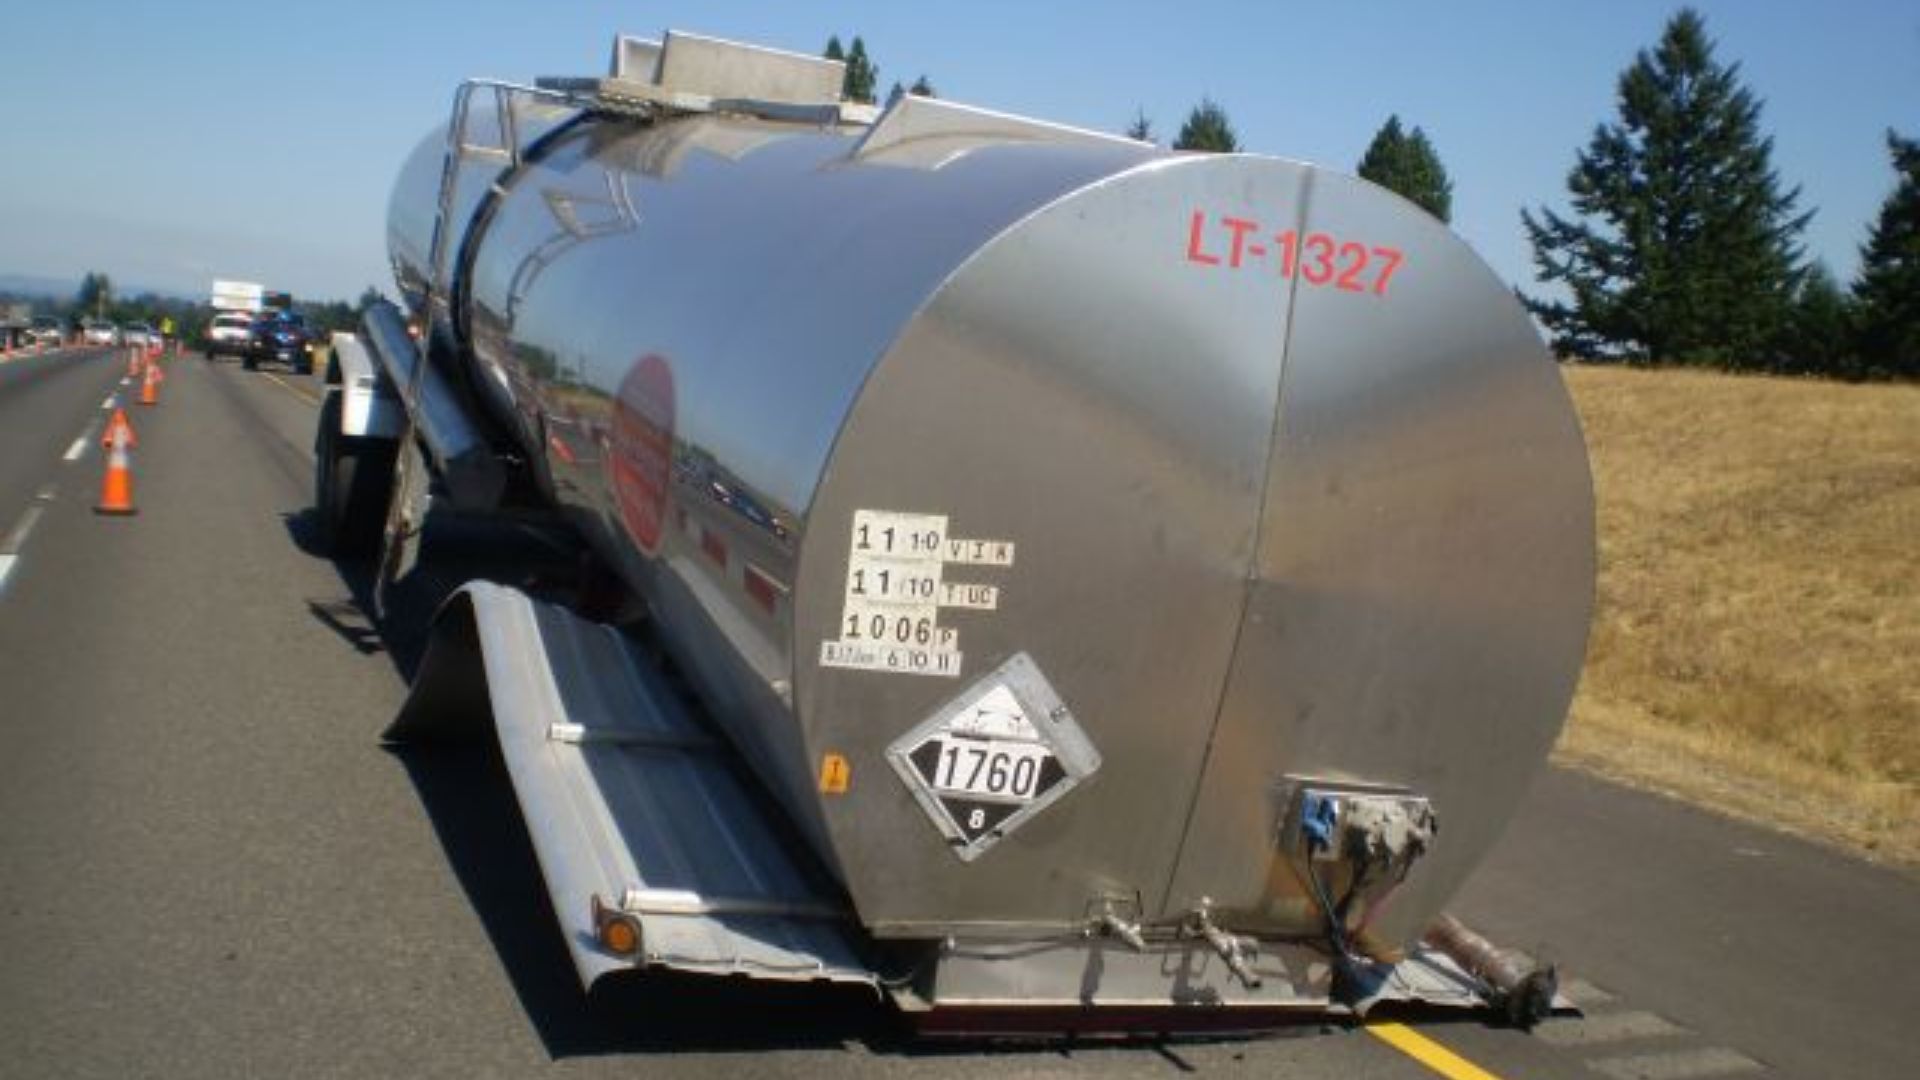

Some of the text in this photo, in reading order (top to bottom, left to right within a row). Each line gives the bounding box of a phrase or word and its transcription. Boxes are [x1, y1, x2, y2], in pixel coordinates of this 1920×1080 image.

[1188, 210, 1403, 296] LT-1327
[944, 747, 1035, 795] 1760
[969, 809, 985, 830] 8
